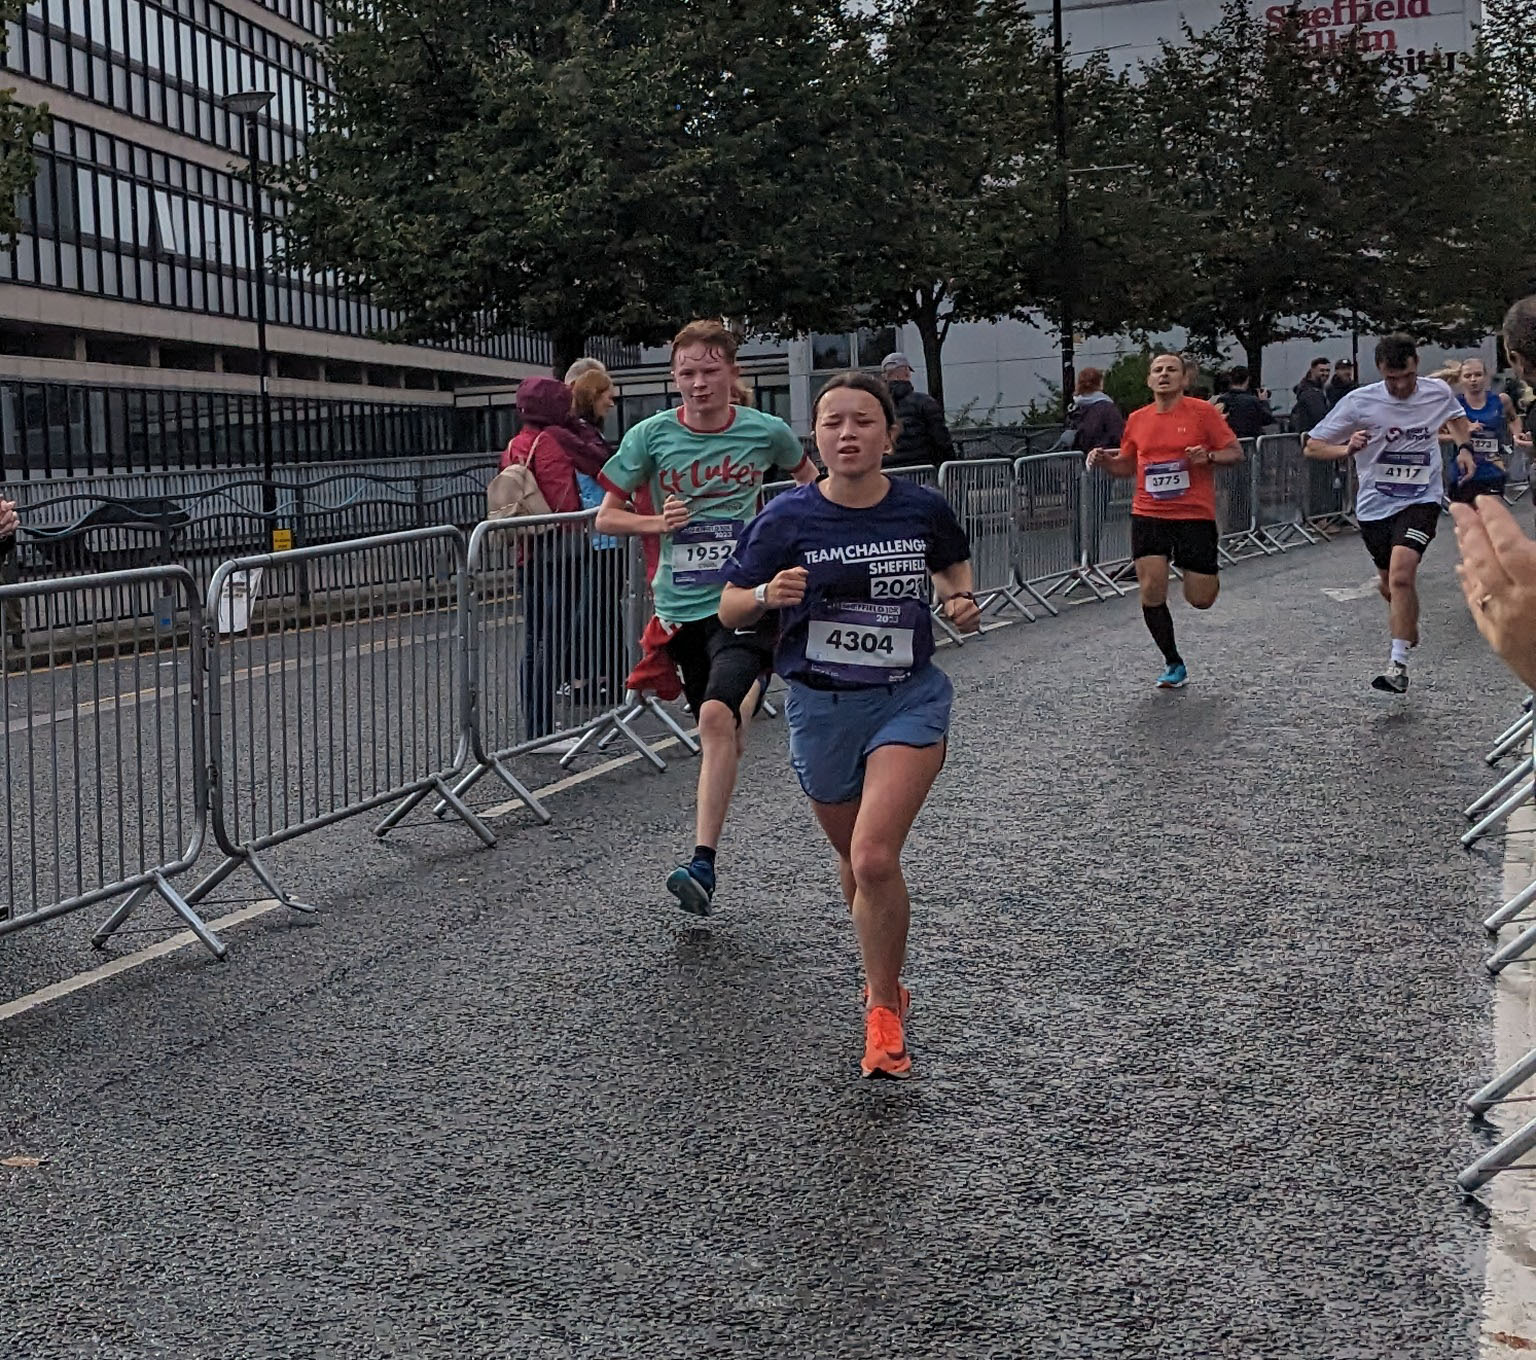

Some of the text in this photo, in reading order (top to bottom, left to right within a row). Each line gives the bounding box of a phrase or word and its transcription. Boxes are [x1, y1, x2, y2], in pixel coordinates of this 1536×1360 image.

[1385, 467, 1422, 479] 4117
[687, 544, 732, 562] 1952
[825, 629, 894, 655] 4304
